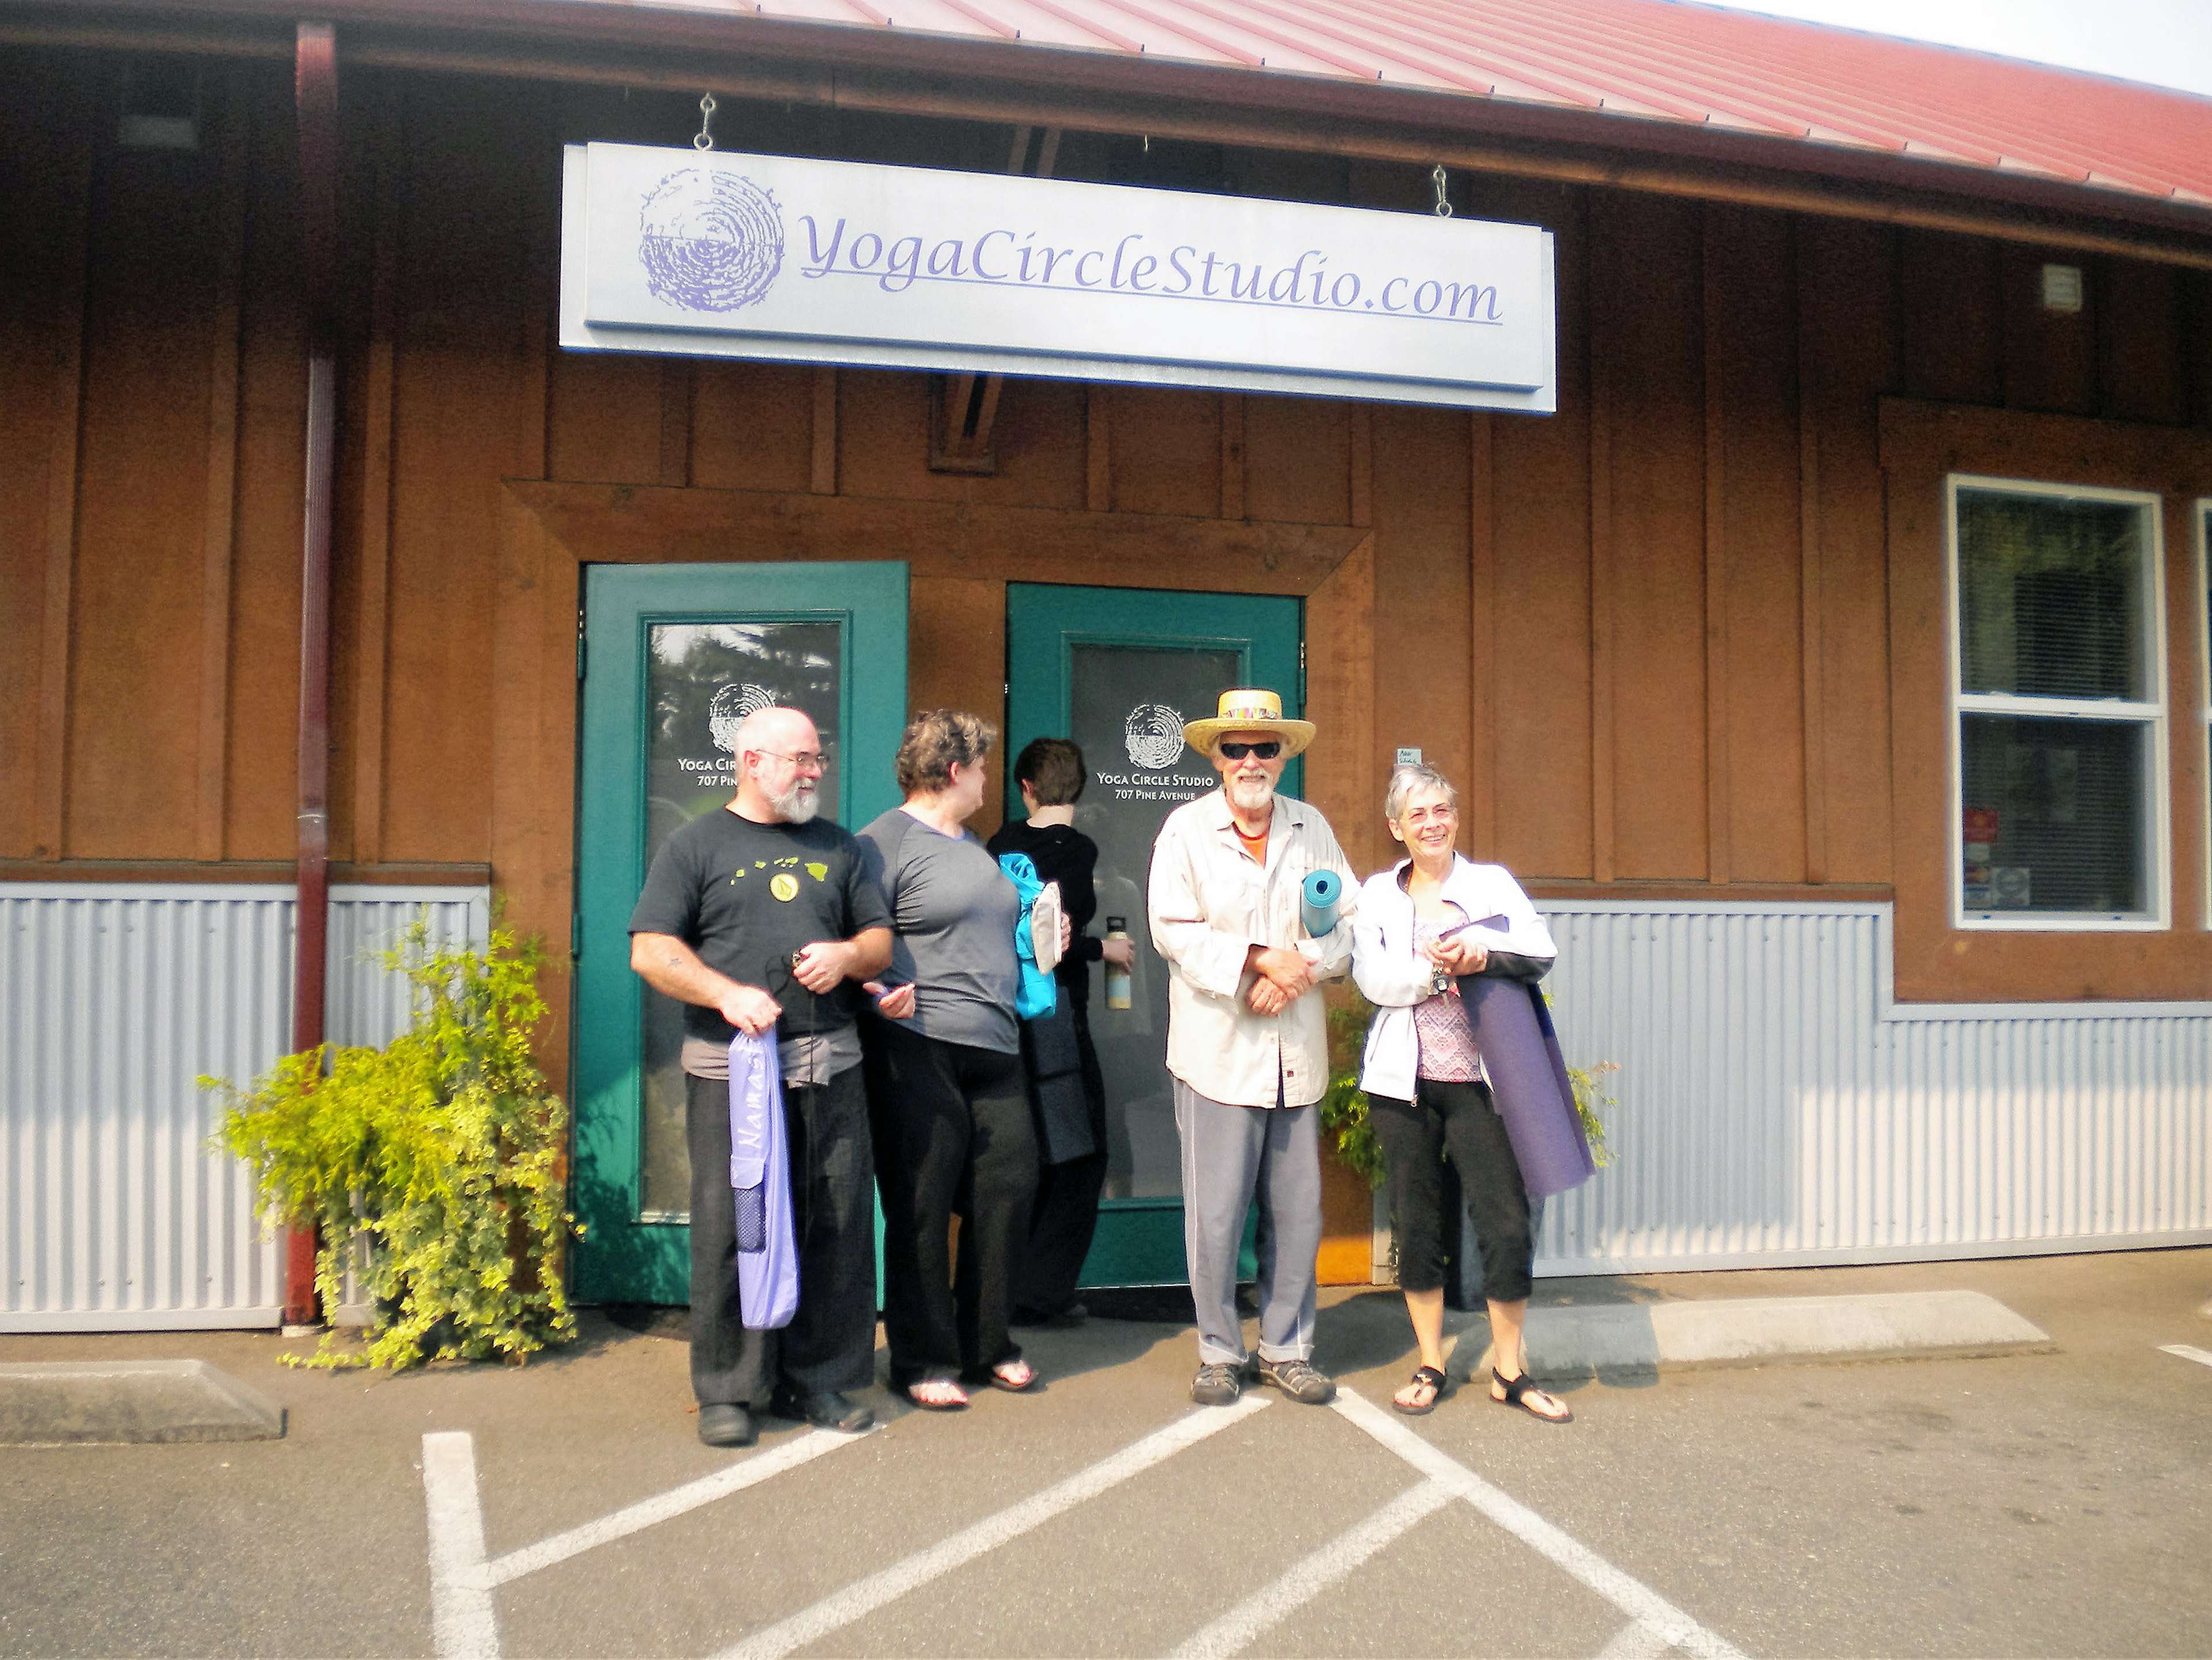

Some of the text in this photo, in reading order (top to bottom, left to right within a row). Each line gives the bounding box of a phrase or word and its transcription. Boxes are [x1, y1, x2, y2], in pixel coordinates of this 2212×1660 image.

[798, 215, 1503, 322] YogaCircleStudio.com
[677, 758, 736, 771] YOGA CIR
[696, 776, 738, 787] 707 PIN
[1096, 773, 1214, 787] YOGA CIRCLE STUDIO
[1115, 789, 1195, 801] 707 PINE AVENUE
